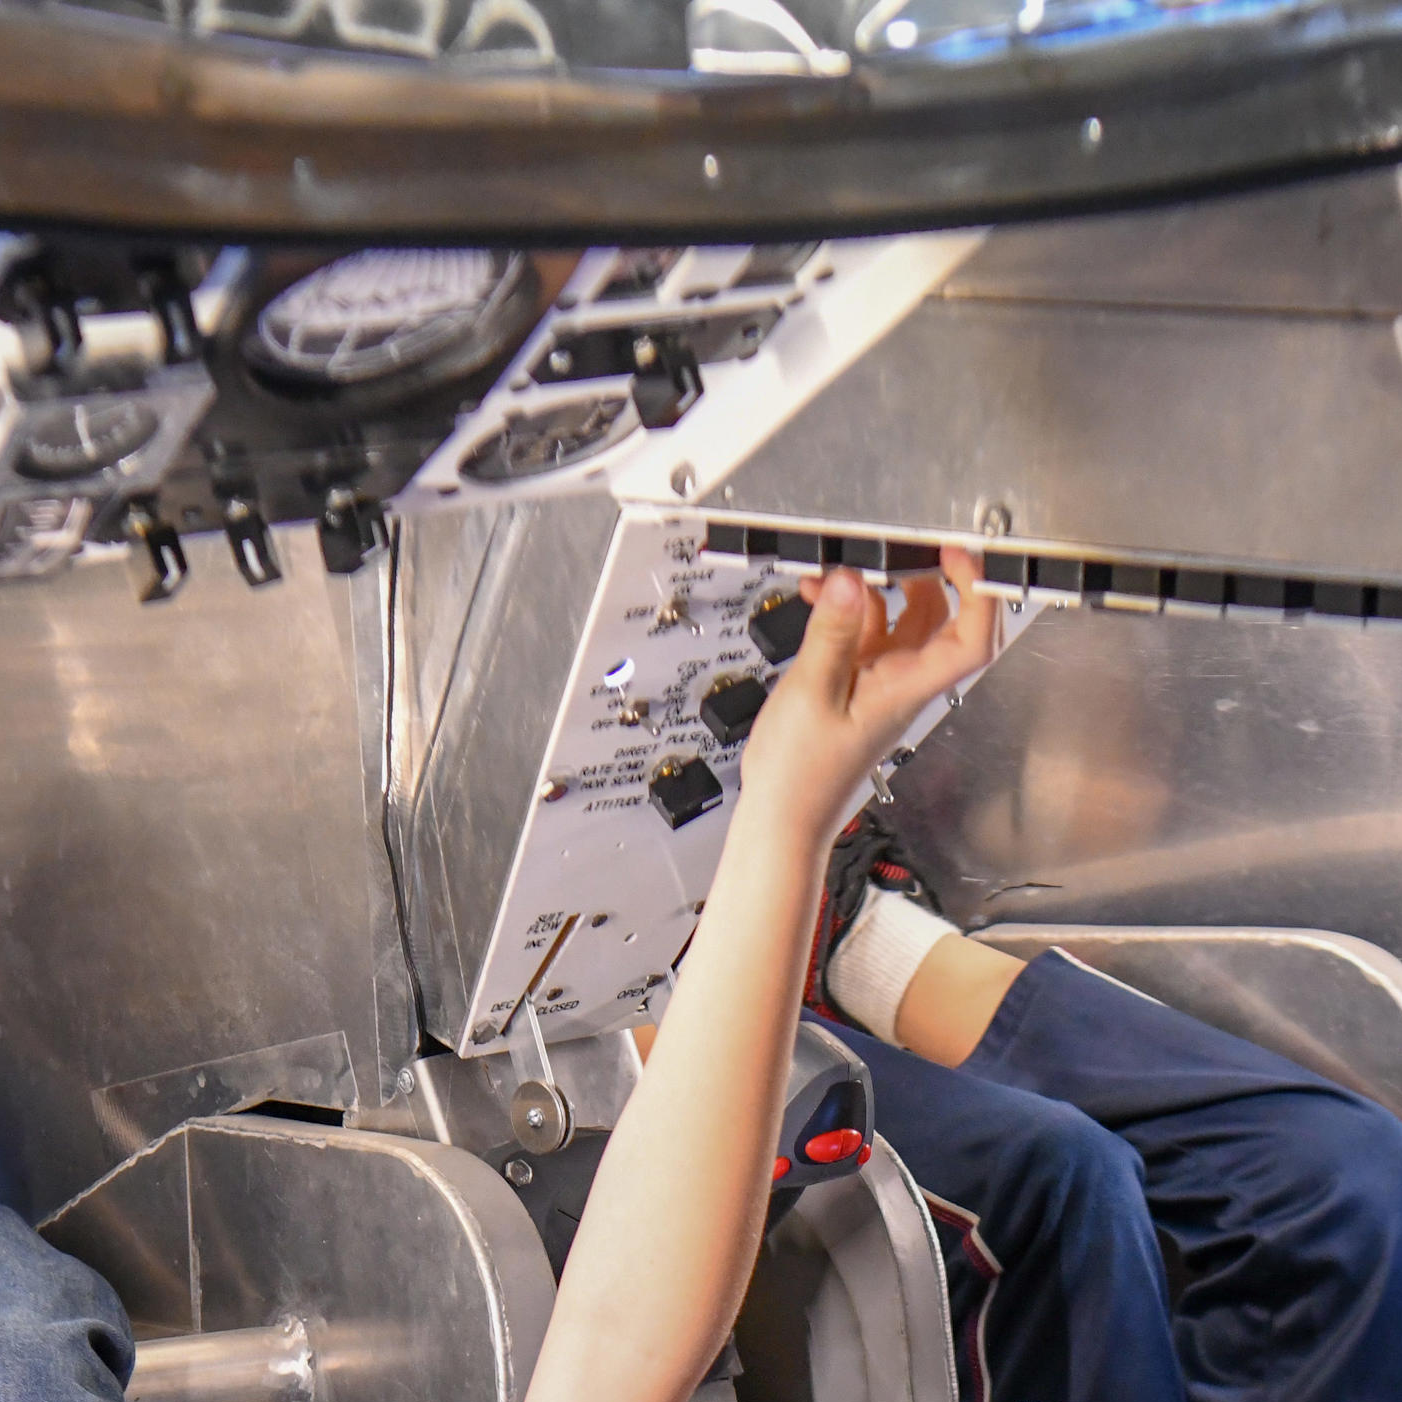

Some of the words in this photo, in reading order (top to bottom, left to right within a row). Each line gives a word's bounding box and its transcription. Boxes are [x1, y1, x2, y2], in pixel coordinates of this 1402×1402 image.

[591, 719, 615, 732] OFF
[614, 743, 661, 759] DIRECT
[580, 763, 614, 777] RATE
[618, 760, 645, 773] CMD
[610, 773, 646, 788] SCAN
[583, 795, 645, 813] ATTITUDE
[527, 921, 562, 935] FLOW
[524, 938, 546, 950] INC
[617, 986, 648, 1000] OPEN
[491, 1000, 515, 1012] DEC
[536, 1000, 579, 1015] CLOSED
